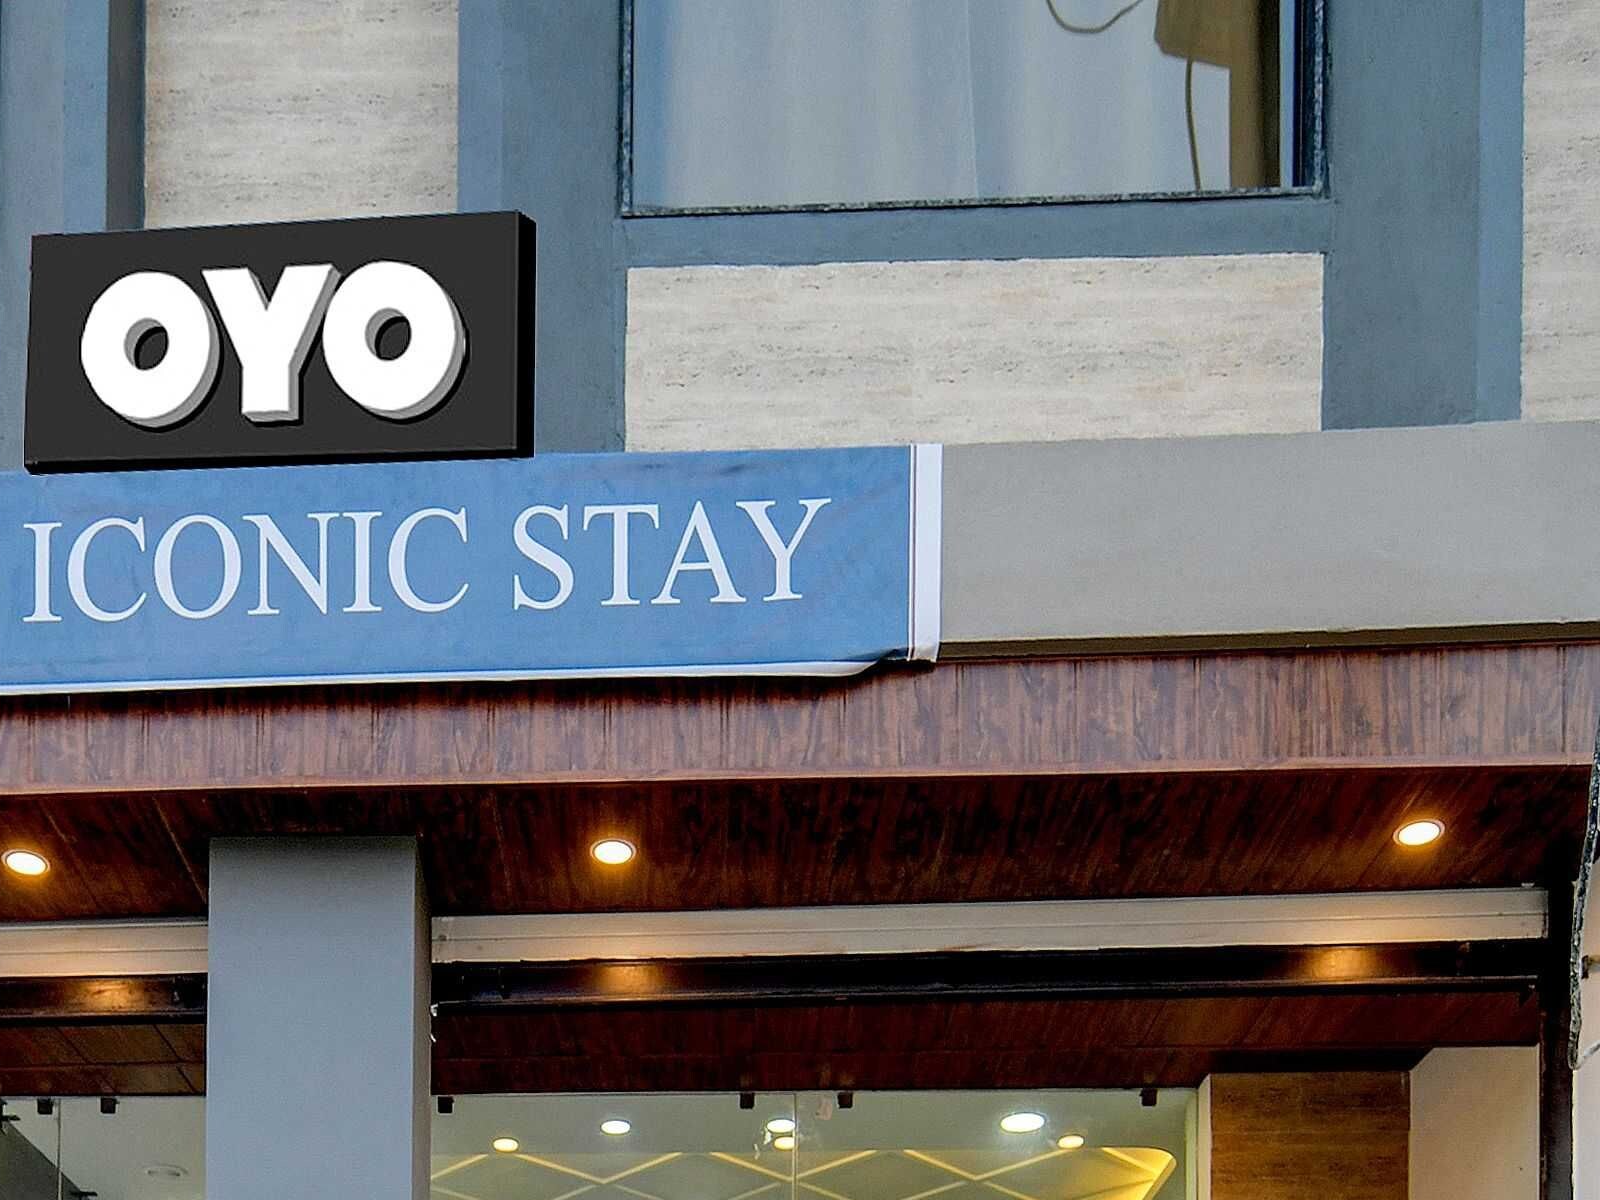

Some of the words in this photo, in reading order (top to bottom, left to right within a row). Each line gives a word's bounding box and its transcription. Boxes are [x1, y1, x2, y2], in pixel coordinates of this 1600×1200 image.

[80, 261, 466, 428] OYO
[23, 506, 470, 622] ICONIC
[512, 497, 832, 610] STAY
